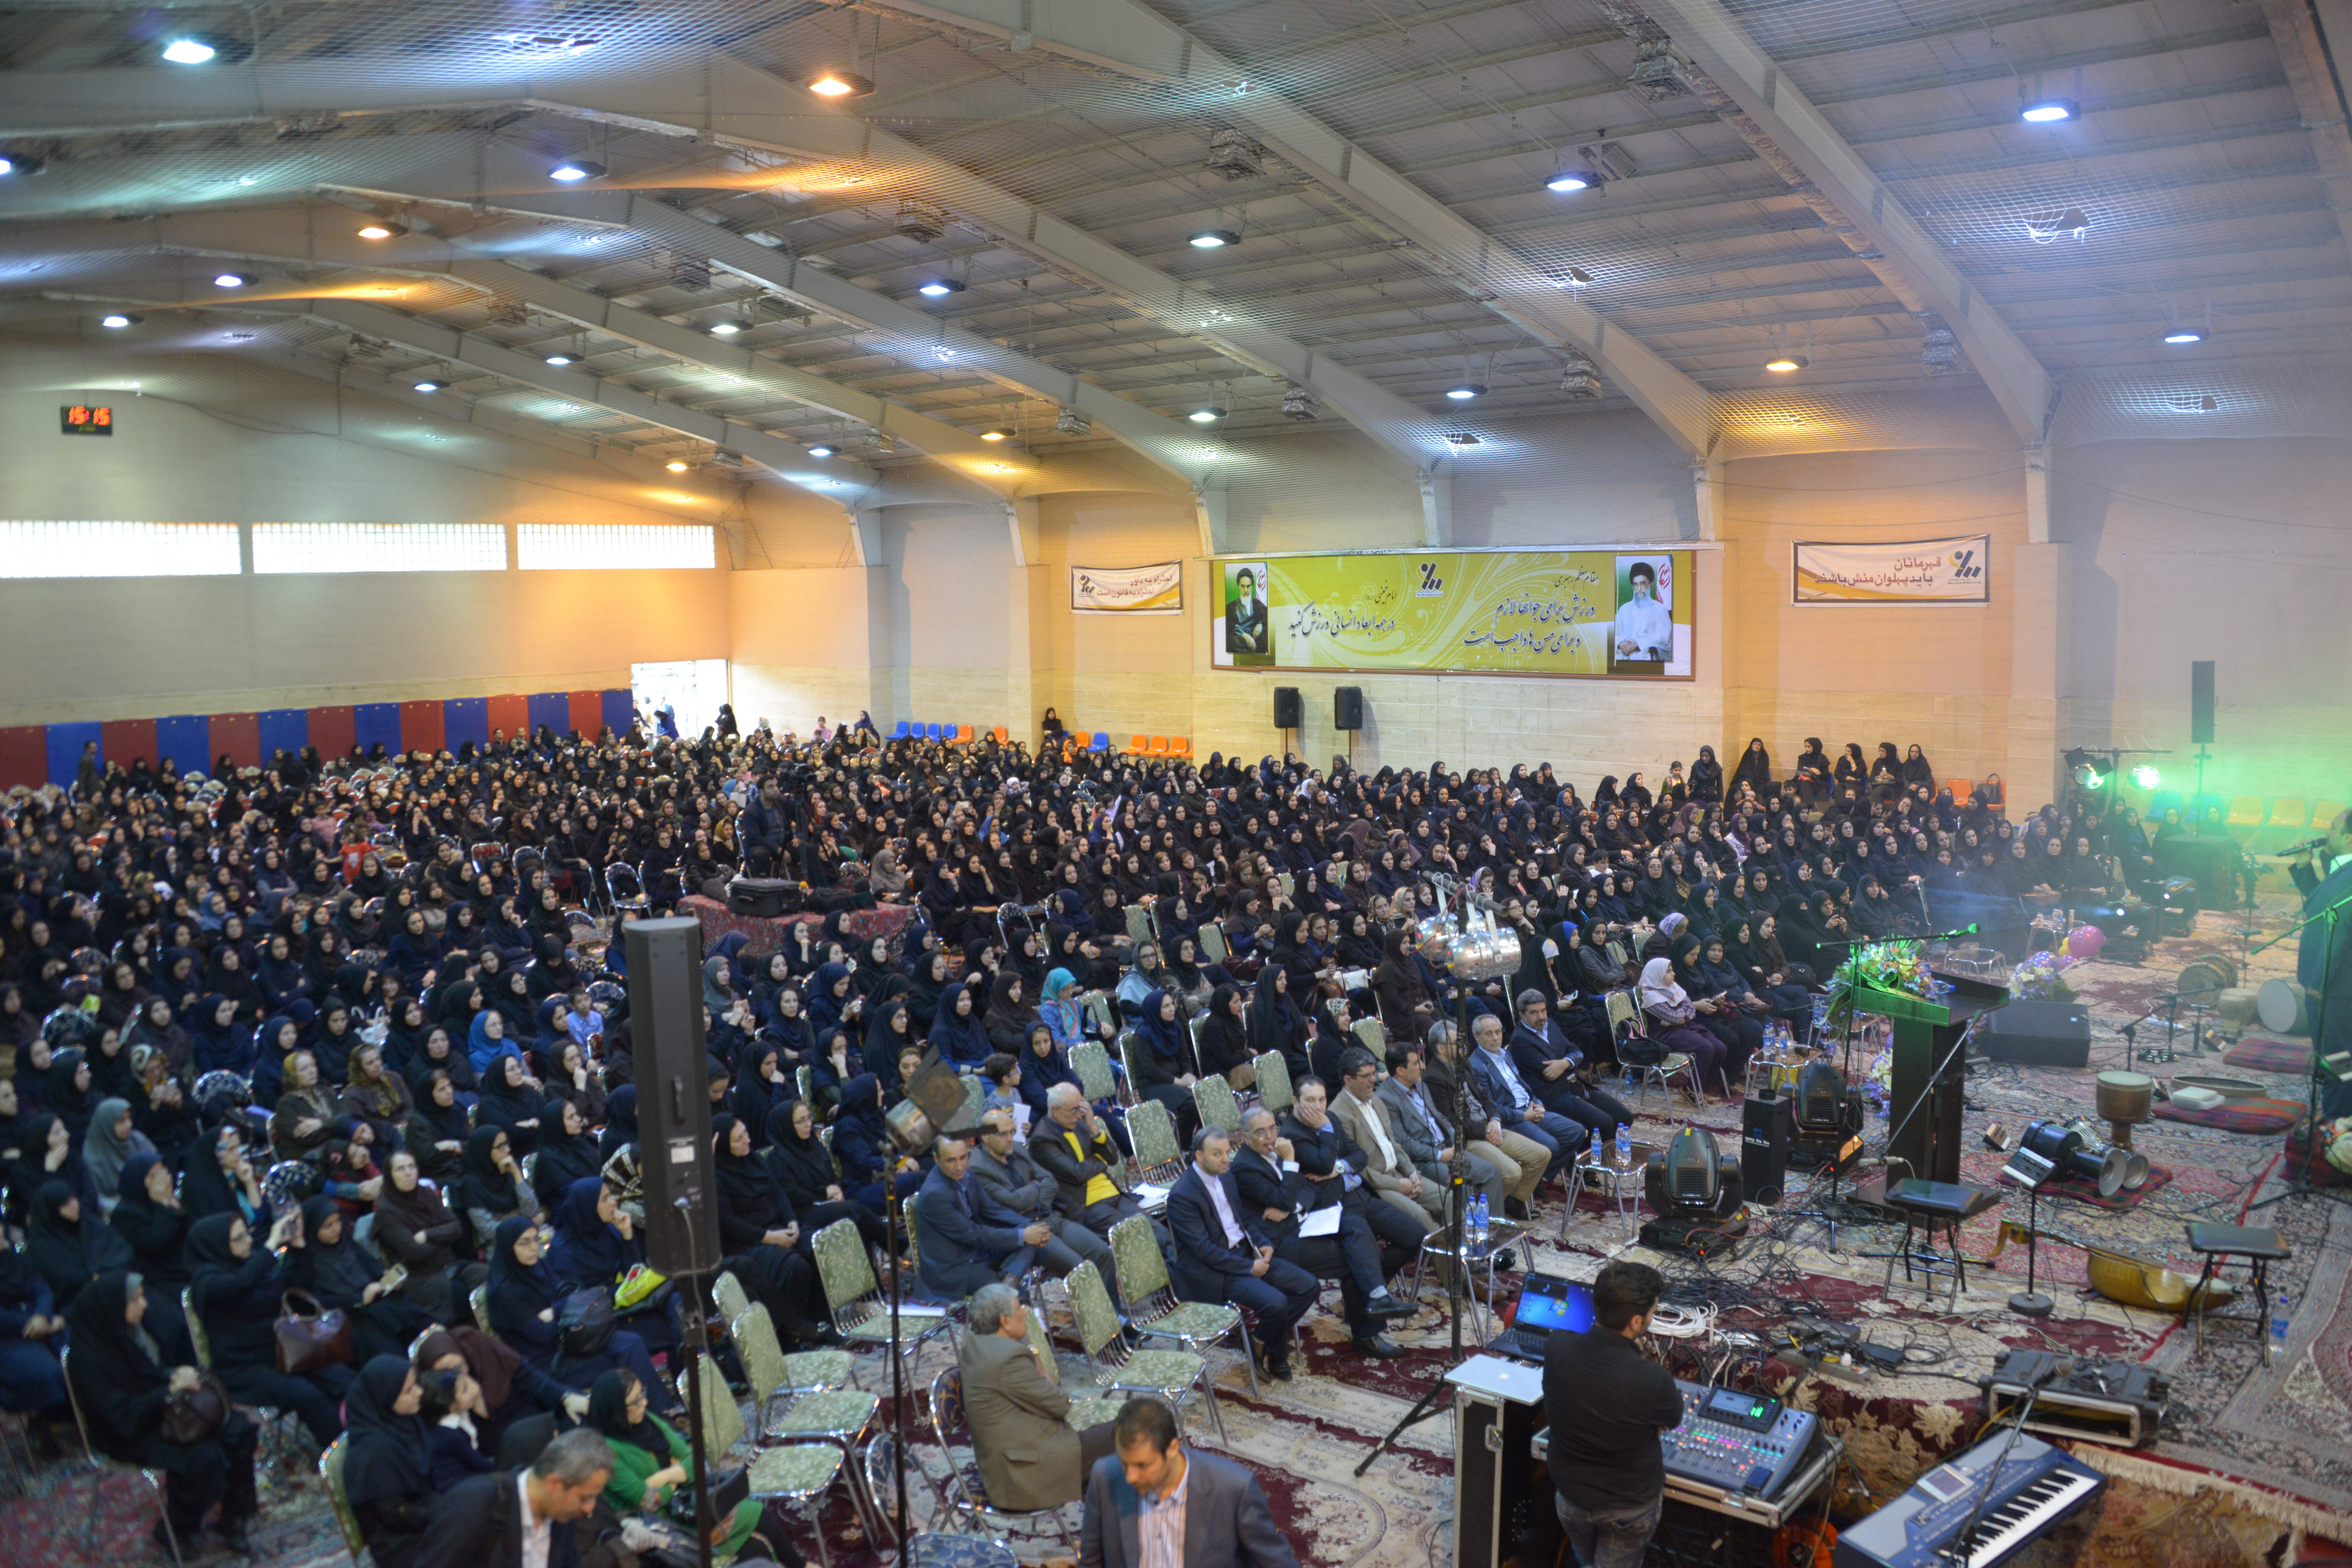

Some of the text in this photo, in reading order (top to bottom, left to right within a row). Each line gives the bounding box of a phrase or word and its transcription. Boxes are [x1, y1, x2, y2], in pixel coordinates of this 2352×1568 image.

[1894, 557, 1941, 571] قهرمانان
[1130, 577, 1143, 587] داور
[1153, 574, 1172, 585] احترام
[1574, 565, 1587, 591] معظم
[1583, 571, 1598, 591] مقام
[1815, 573, 1933, 587] باید پهلوان منش باشند
[1111, 588, 1129, 598] قانون
[1136, 588, 1154, 597] احترام
[1375, 580, 1388, 604] خمینی
[1385, 591, 1397, 608] امام
[1493, 597, 1516, 628] لازم
[1539, 596, 1564, 623] برای
[1562, 593, 1595, 623] ورزش
[1288, 600, 1395, 637] در همه ابعاد انسانی ورزش کنید
[1464, 629, 1494, 646] است
[1493, 630, 1527, 652] واجب
[1550, 631, 1575, 654] برای
